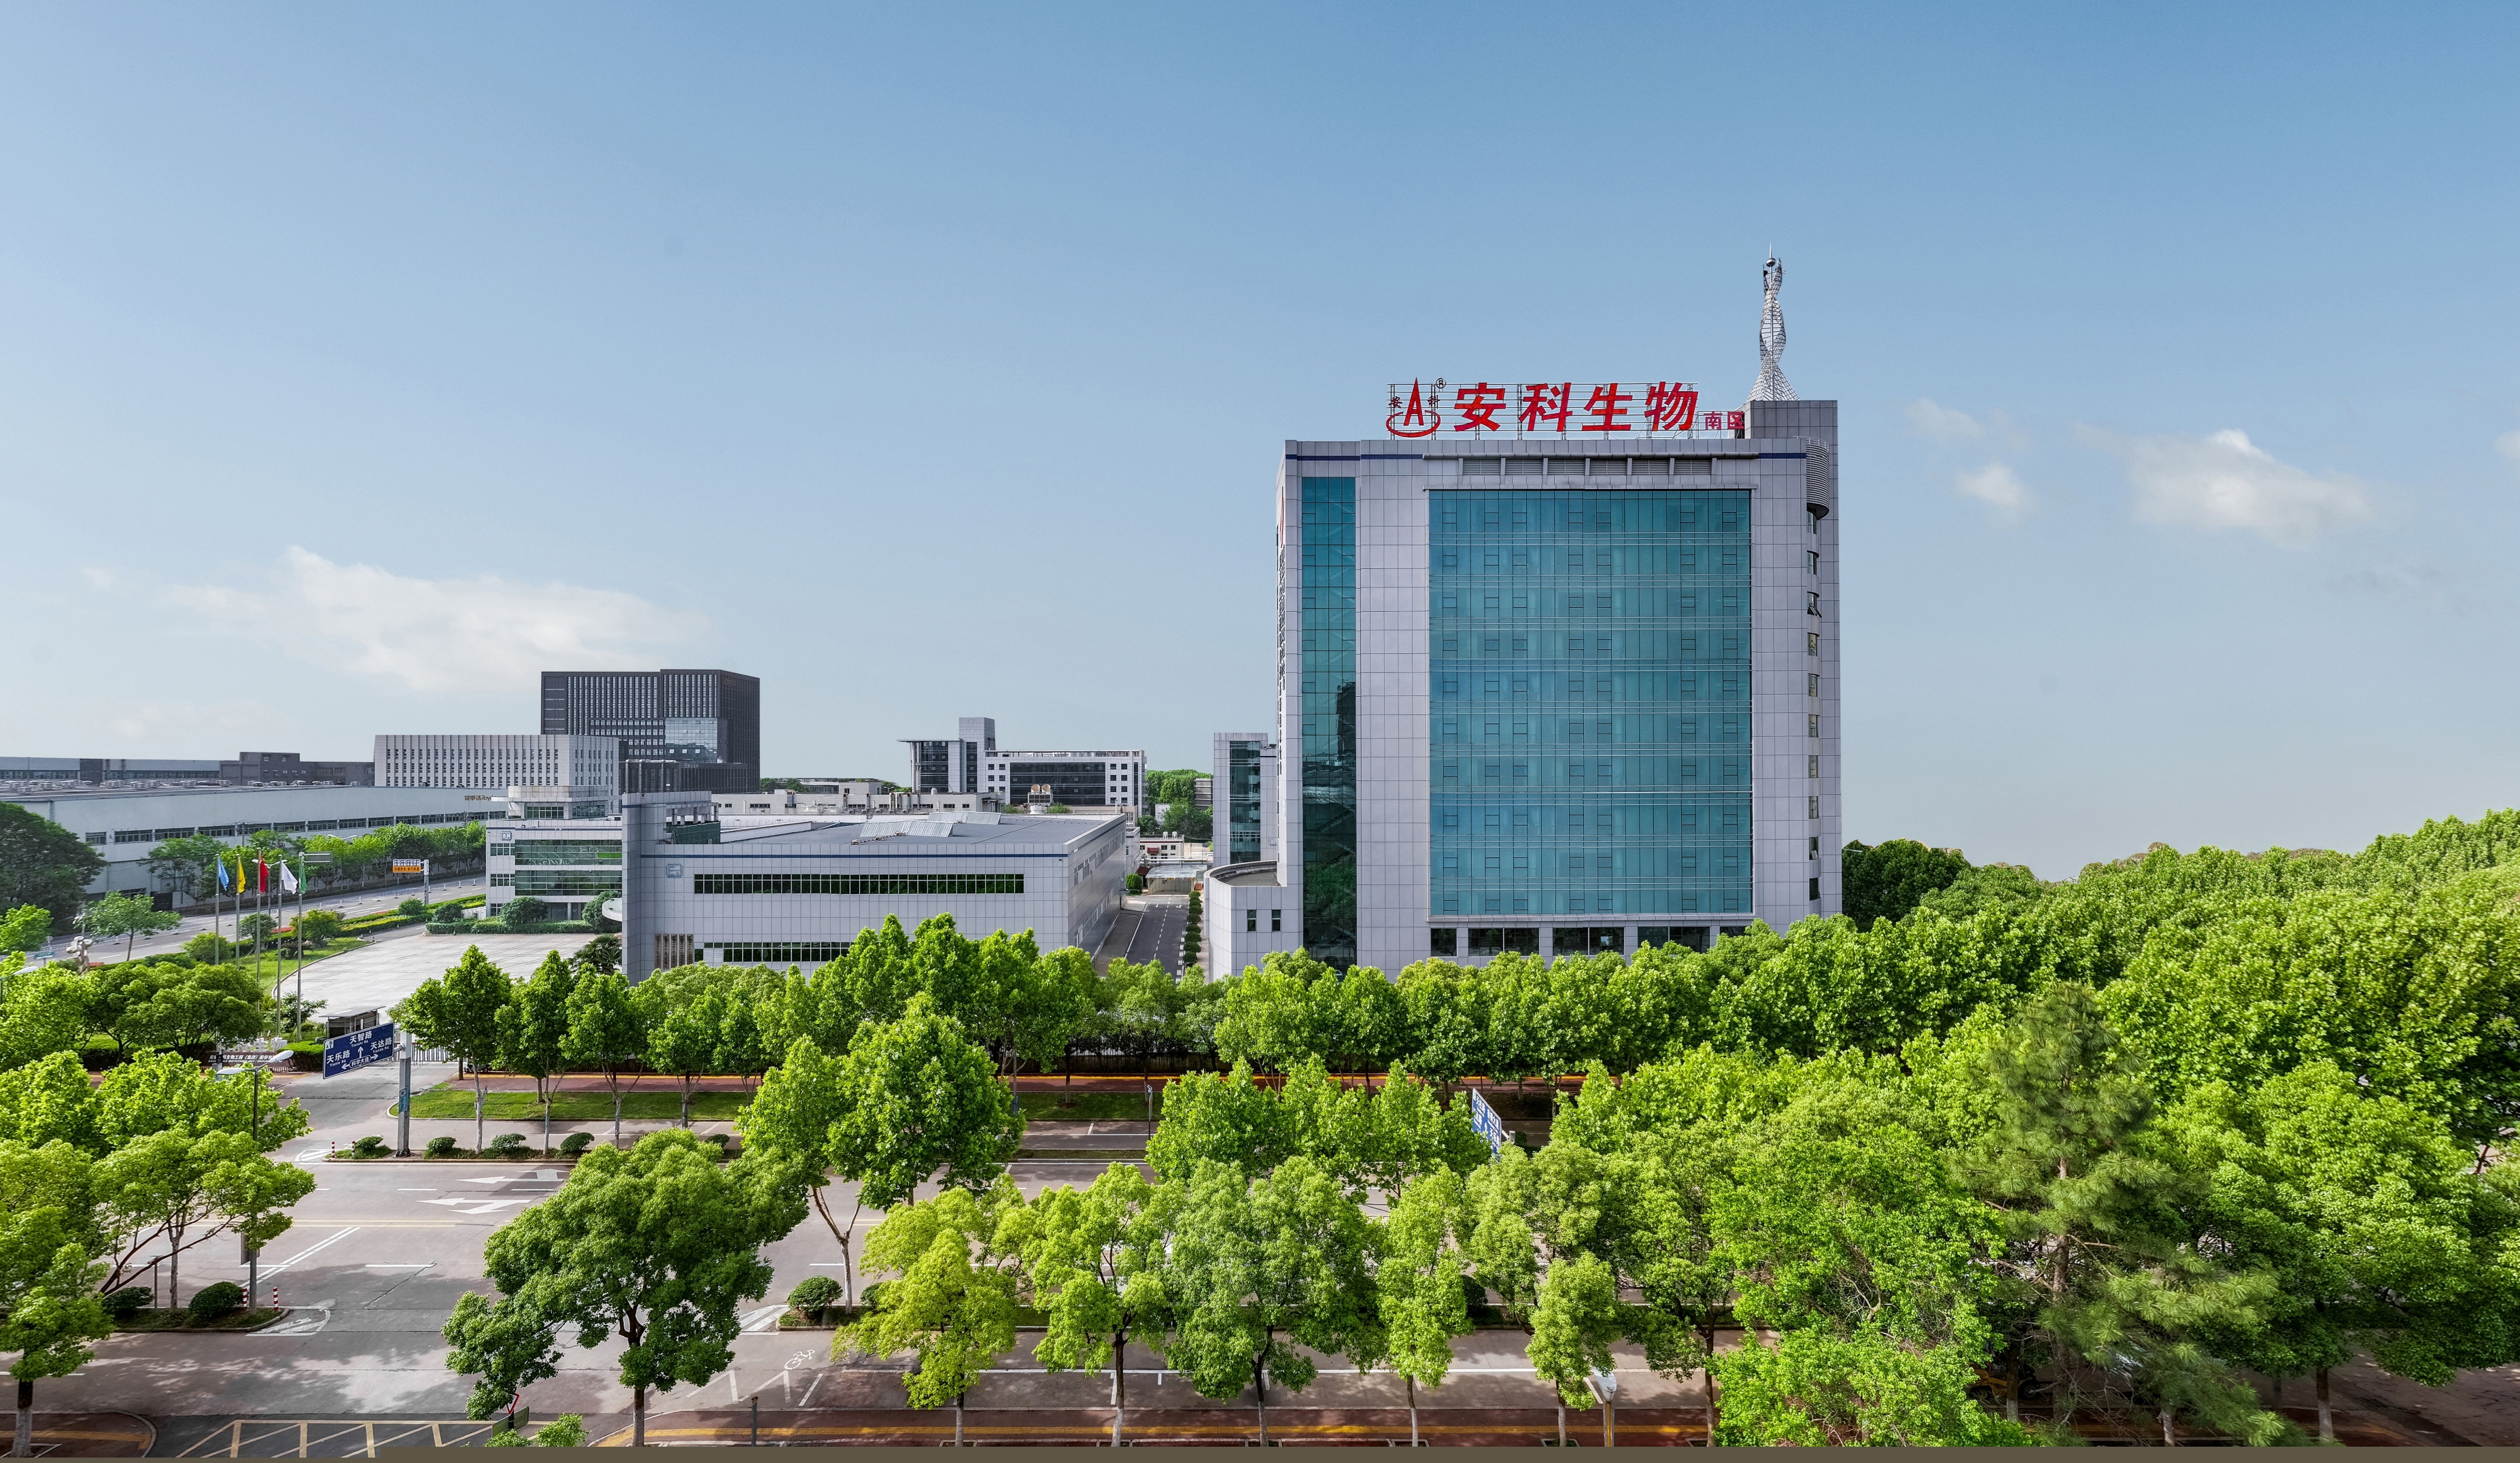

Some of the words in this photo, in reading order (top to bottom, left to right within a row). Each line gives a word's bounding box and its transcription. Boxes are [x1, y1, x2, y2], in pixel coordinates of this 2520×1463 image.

[1454, 381, 1698, 432] 安科生物
[1703, 411, 1745, 430] 南区
[349, 1031, 373, 1044] 天智路
[370, 1037, 392, 1050] 天达路
[326, 1049, 351, 1065] 天乐路
[351, 1056, 370, 1067] 科学大道
